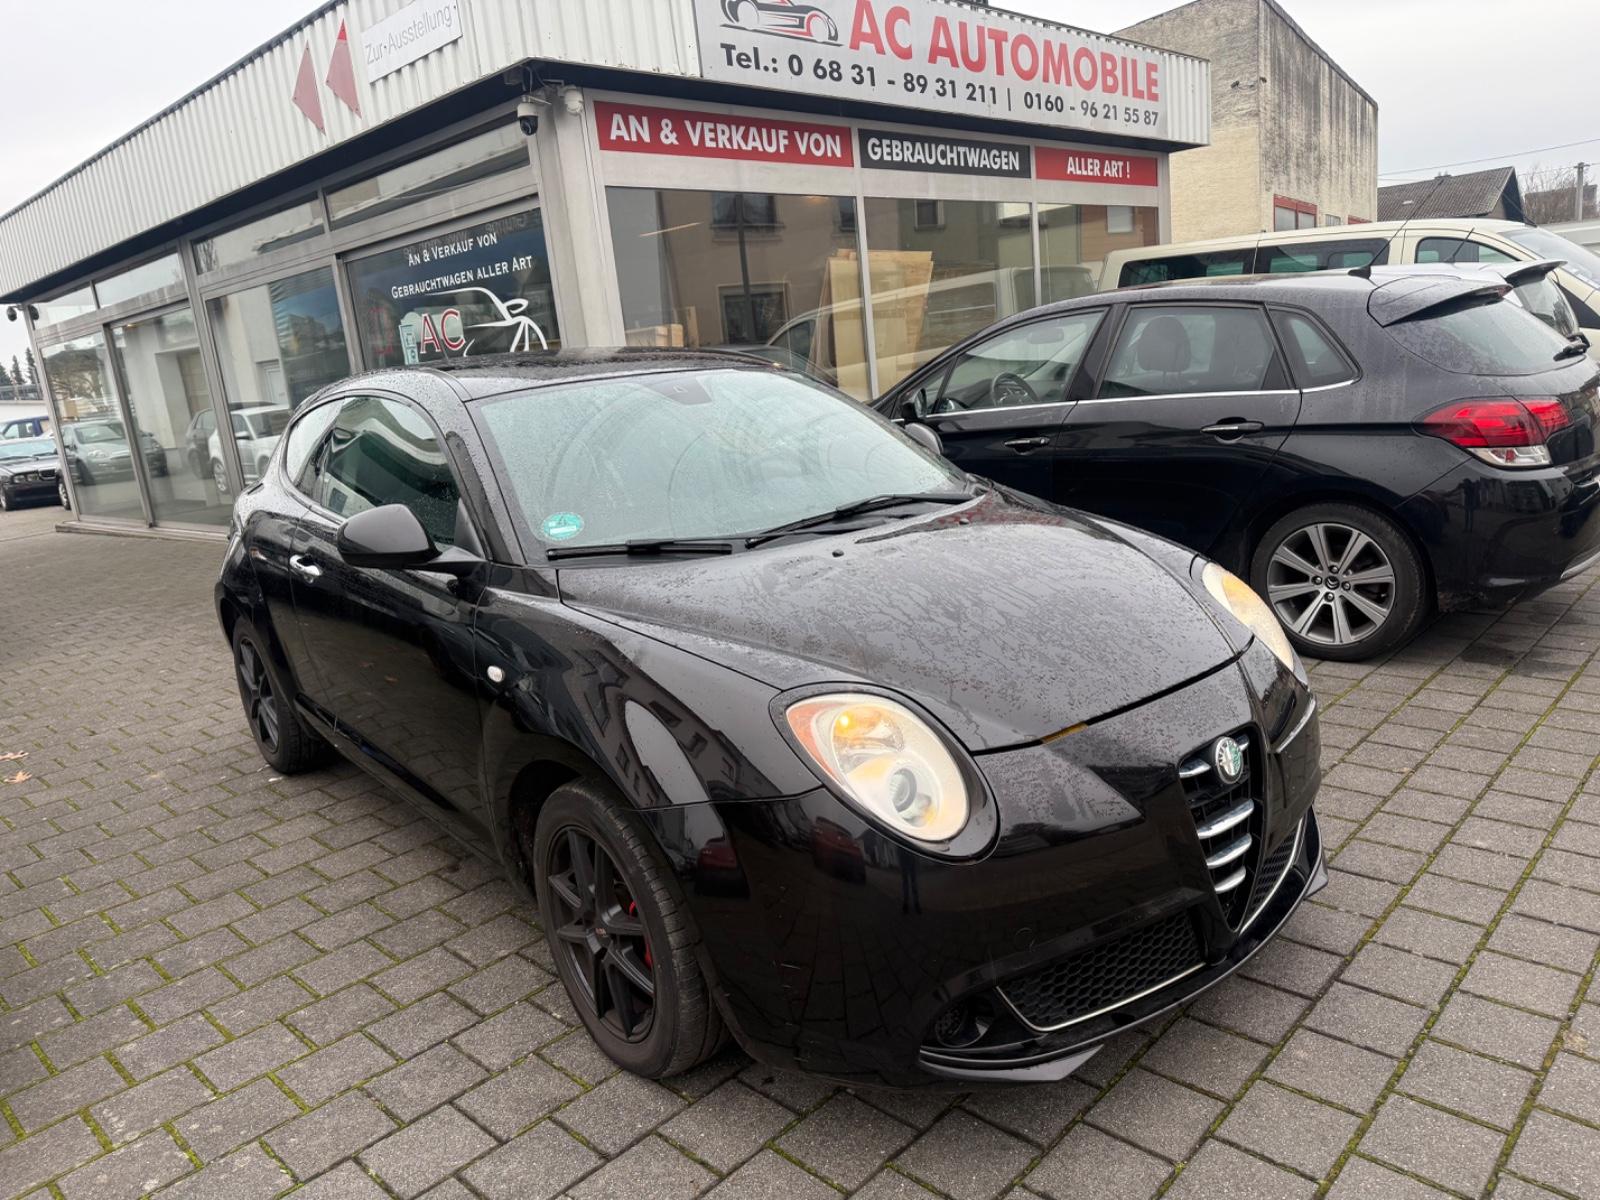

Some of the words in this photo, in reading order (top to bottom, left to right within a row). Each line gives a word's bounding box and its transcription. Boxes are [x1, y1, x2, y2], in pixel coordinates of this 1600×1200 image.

[366, 42, 383, 65] Zur
[387, 5, 453, 55] Ausstellung
[849, 0, 913, 60] AC
[928, 16, 1160, 101] AUTOMOBILE
[720, 43, 778, 73] Tel.:
[788, 54, 803, 76] 0
[813, 58, 843, 82] 68
[851, 64, 876, 87] 31
[903, 72, 928, 94] 89
[935, 77, 957, 98] 31
[966, 82, 997, 105] 211
[1024, 91, 1064, 113] 0160
[1081, 100, 1098, 118] 96
[1103, 103, 1118, 121] 21
[1124, 107, 1140, 124] 55
[1144, 110, 1159, 127] 87
[610, 112, 650, 143] AN
[659, 118, 679, 146] &
[684, 120, 789, 154] VERKAUF
[794, 130, 842, 158] VON
[867, 137, 1020, 171] GEBRAUCHTWAGEN
[1066, 156, 1100, 177] ALLER
[1103, 160, 1124, 178] ART
[1126, 161, 1131, 179] !
[422, 249, 431, 262] &
[420, 308, 466, 354] AC
